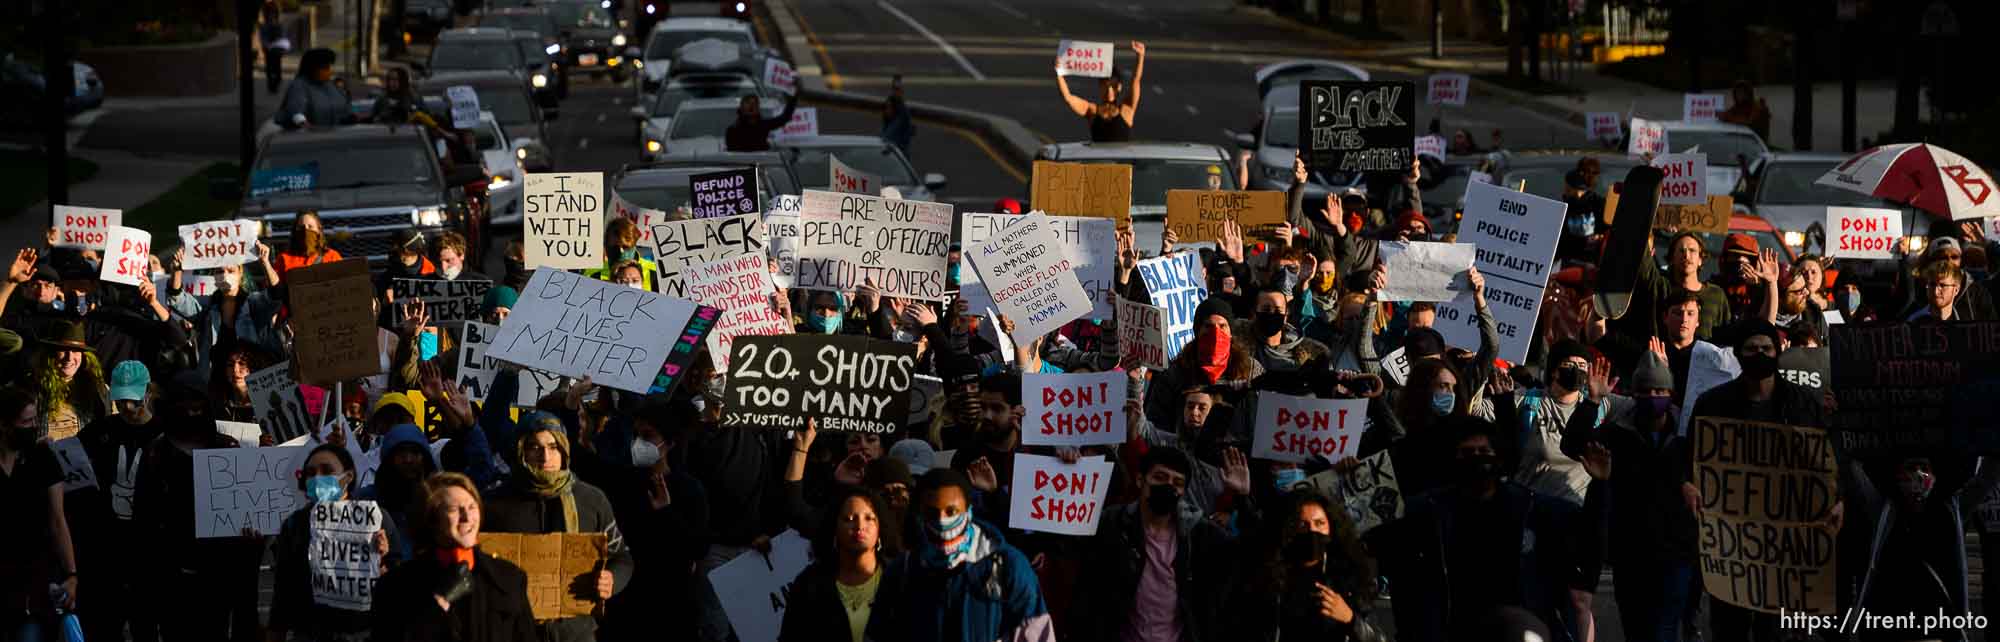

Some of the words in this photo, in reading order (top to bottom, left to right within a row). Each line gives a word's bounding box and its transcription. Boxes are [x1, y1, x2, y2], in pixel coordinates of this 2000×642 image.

[1065, 60, 1104, 72] SHOOT
[1311, 85, 1408, 129] BLACK
[1311, 127, 1366, 151] LIVES
[1662, 159, 1694, 178] ONT
[552, 176, 571, 192] I
[694, 175, 745, 193] DEFUND
[1660, 180, 1697, 198] HOOT
[527, 194, 596, 213] STAND
[697, 189, 745, 206] POLICE
[768, 198, 800, 212] ACK
[841, 196, 878, 221] ARE
[885, 200, 917, 223] YOU
[1196, 194, 1209, 208] IF
[1498, 198, 1528, 217] END
[706, 203, 737, 218] HEX
[64, 231, 108, 244] SHOO
[528, 217, 591, 237] WITH
[652, 217, 762, 257] BLACK
[763, 223, 796, 237] IVES
[804, 221, 865, 247] PEACE
[876, 227, 949, 258] OFFICERS
[983, 240, 1002, 256] ALL
[1001, 222, 1038, 245] MOTHERS
[1174, 222, 1193, 238] GO
[1196, 222, 1226, 241] FUC
[1476, 220, 1530, 245] POLICE
[193, 241, 246, 259] SHOOT
[543, 240, 592, 258] YOU.
[1003, 240, 1026, 257] WERE
[1839, 234, 1893, 251] SHOOT
[703, 261, 732, 279] MAN
[734, 254, 762, 273] WHO
[862, 251, 881, 266] OR
[993, 243, 1046, 277] SUMMONED
[1475, 247, 1544, 275] RUTALITY
[993, 278, 1036, 304] GEORGE
[1035, 260, 1071, 282] FLOYD
[1014, 263, 1037, 280] WHEN
[1139, 253, 1199, 294] BLACK
[539, 270, 657, 320] BLACK
[690, 276, 739, 302] STANDS
[738, 271, 762, 291] FOR
[1013, 286, 1044, 307] CALLED
[1044, 278, 1060, 293] OUT
[1483, 284, 1535, 311] USTICE
[1025, 299, 1044, 313] FOR
[1044, 292, 1058, 305] HIS
[1029, 301, 1068, 326] MOMMA
[555, 308, 631, 341] LIVES
[735, 308, 765, 324] FALL
[1437, 305, 1459, 321] NO
[1467, 313, 1517, 338] PCE
[506, 323, 648, 377] MATTER
[809, 344, 914, 392] SHOTS
[736, 385, 790, 407] TOO
[801, 389, 892, 420] MANY
[822, 417, 897, 434] BERNARDO
[1040, 410, 1113, 436] SHOOT
[1271, 431, 1349, 457] SHOOT
[1696, 420, 1832, 473] DEMILITARIZE
[208, 454, 290, 491] BLAC
[210, 487, 297, 512] LIVES
[1700, 464, 1829, 521] DEFUND
[317, 504, 377, 526] BLACK
[1030, 494, 1096, 524] SHOOT
[321, 540, 371, 563] LIVES
[1718, 517, 1832, 566] DISBAND
[1700, 554, 1728, 577] THE
[1729, 561, 1820, 612] POLICE
